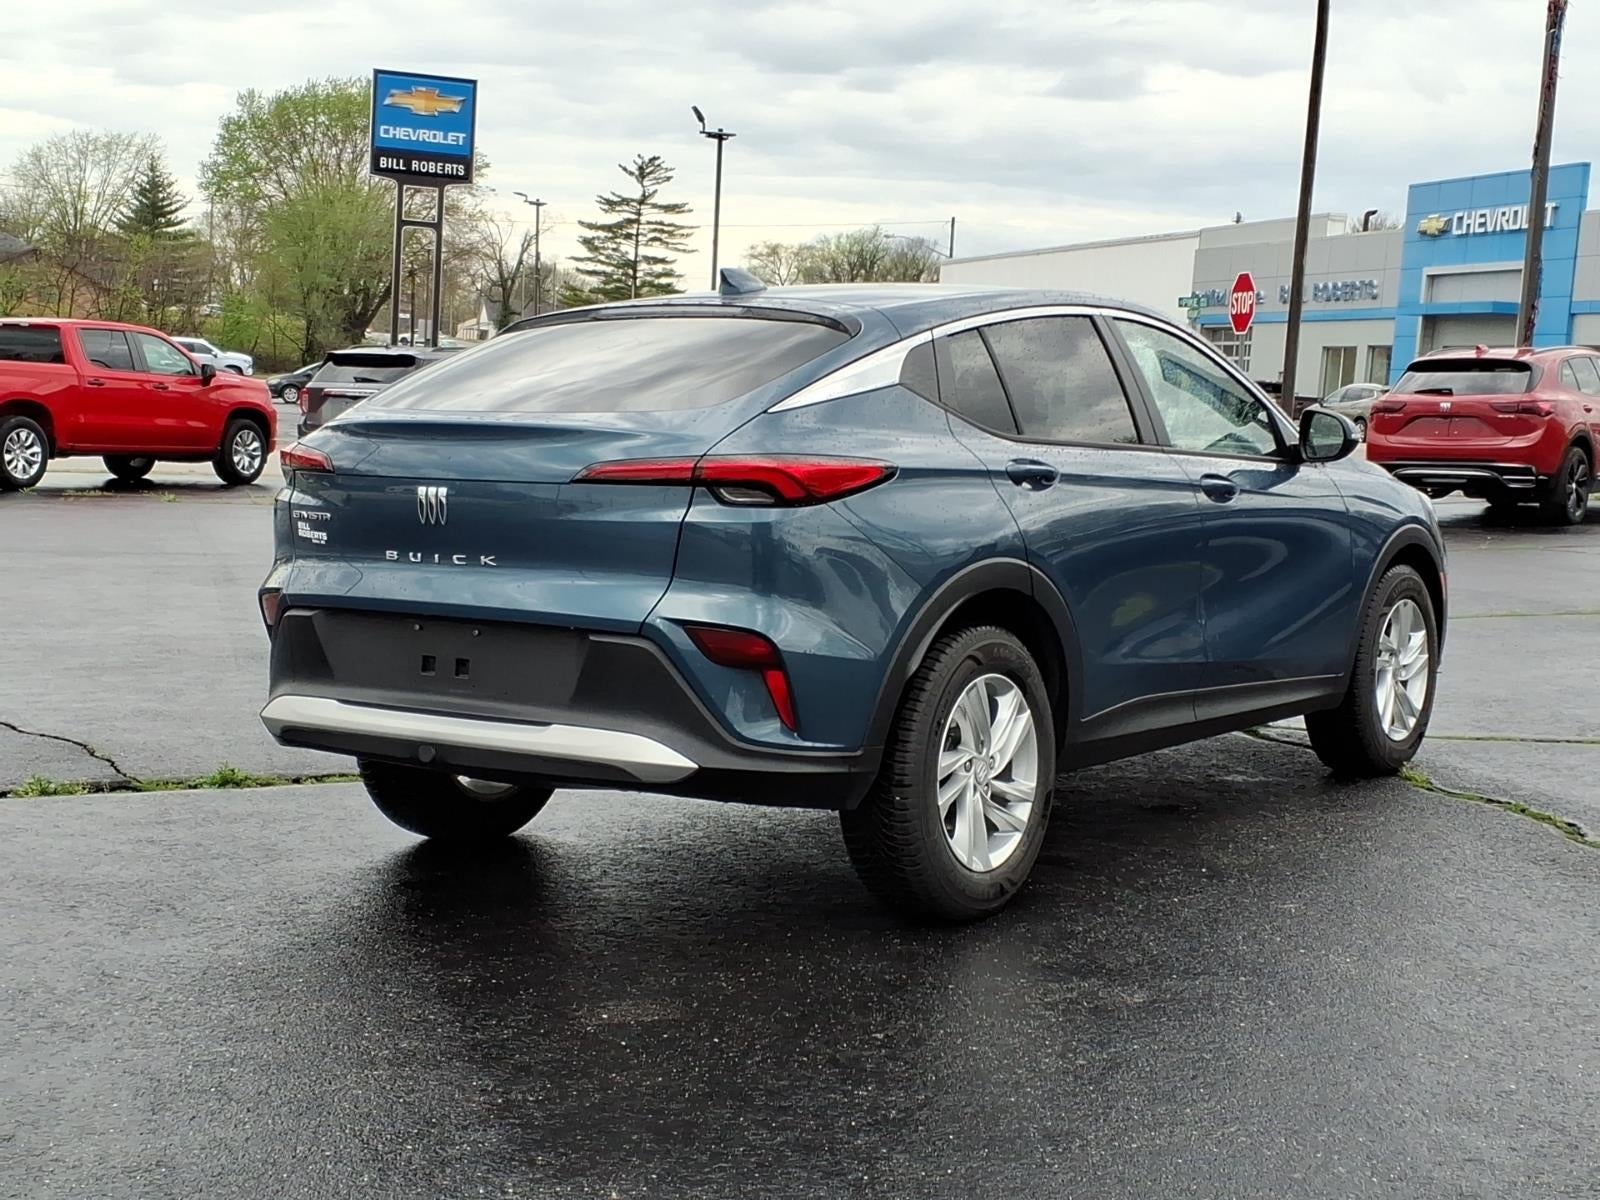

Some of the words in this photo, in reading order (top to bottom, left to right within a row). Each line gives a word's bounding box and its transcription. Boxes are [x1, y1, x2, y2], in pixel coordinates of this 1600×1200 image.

[380, 125, 466, 145] CHEVROLET
[380, 157, 406, 170] BILL
[412, 160, 465, 176] ROBERTS
[1452, 202, 1558, 235] CHEVROLT
[1232, 291, 1254, 315] STOP
[298, 529, 327, 540] ROBERTS
[386, 550, 497, 567] BUICK
